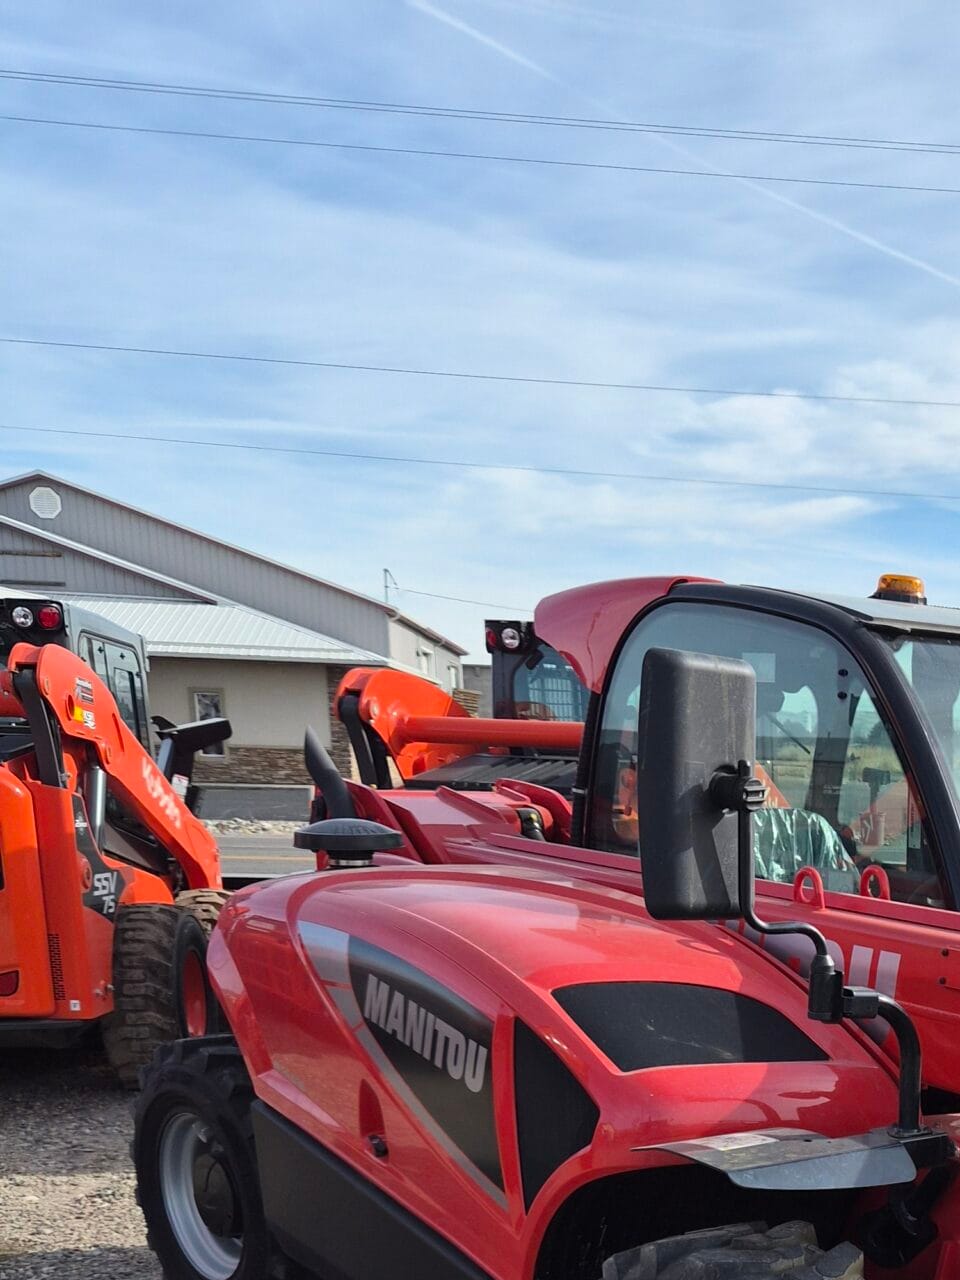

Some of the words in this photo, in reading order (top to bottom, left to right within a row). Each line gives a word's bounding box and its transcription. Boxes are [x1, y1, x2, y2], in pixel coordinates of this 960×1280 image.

[93, 871, 117, 896] SSV
[102, 895, 116, 914] 75
[364, 973, 488, 1093] MANITOU
